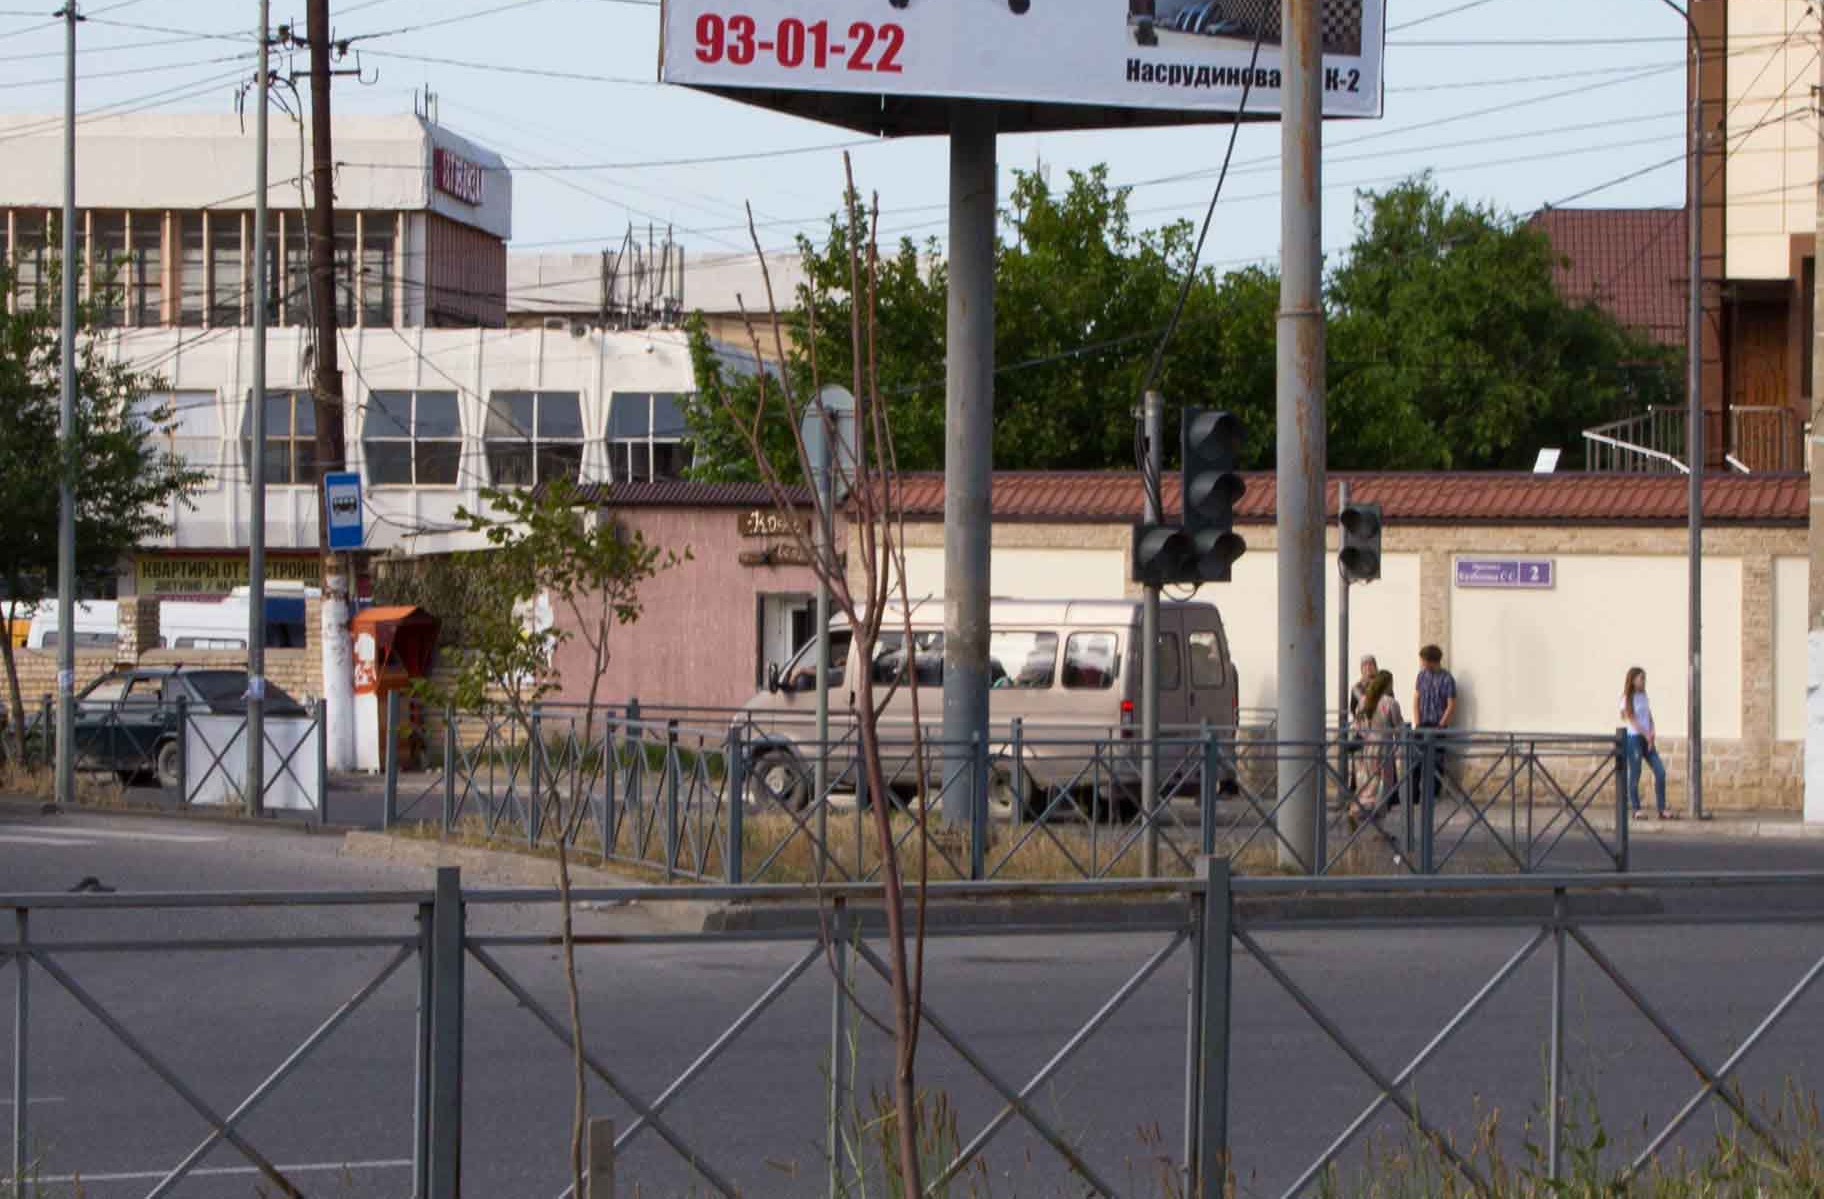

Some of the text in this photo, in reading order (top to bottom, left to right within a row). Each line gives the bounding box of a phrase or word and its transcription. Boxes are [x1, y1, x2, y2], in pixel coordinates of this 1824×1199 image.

[695, 13, 905, 73] 93-01-22
[1126, 58, 1281, 89] Насрудинова
[142, 560, 218, 579] КВАРТИРЫ
[222, 560, 240, 579] ОТ
